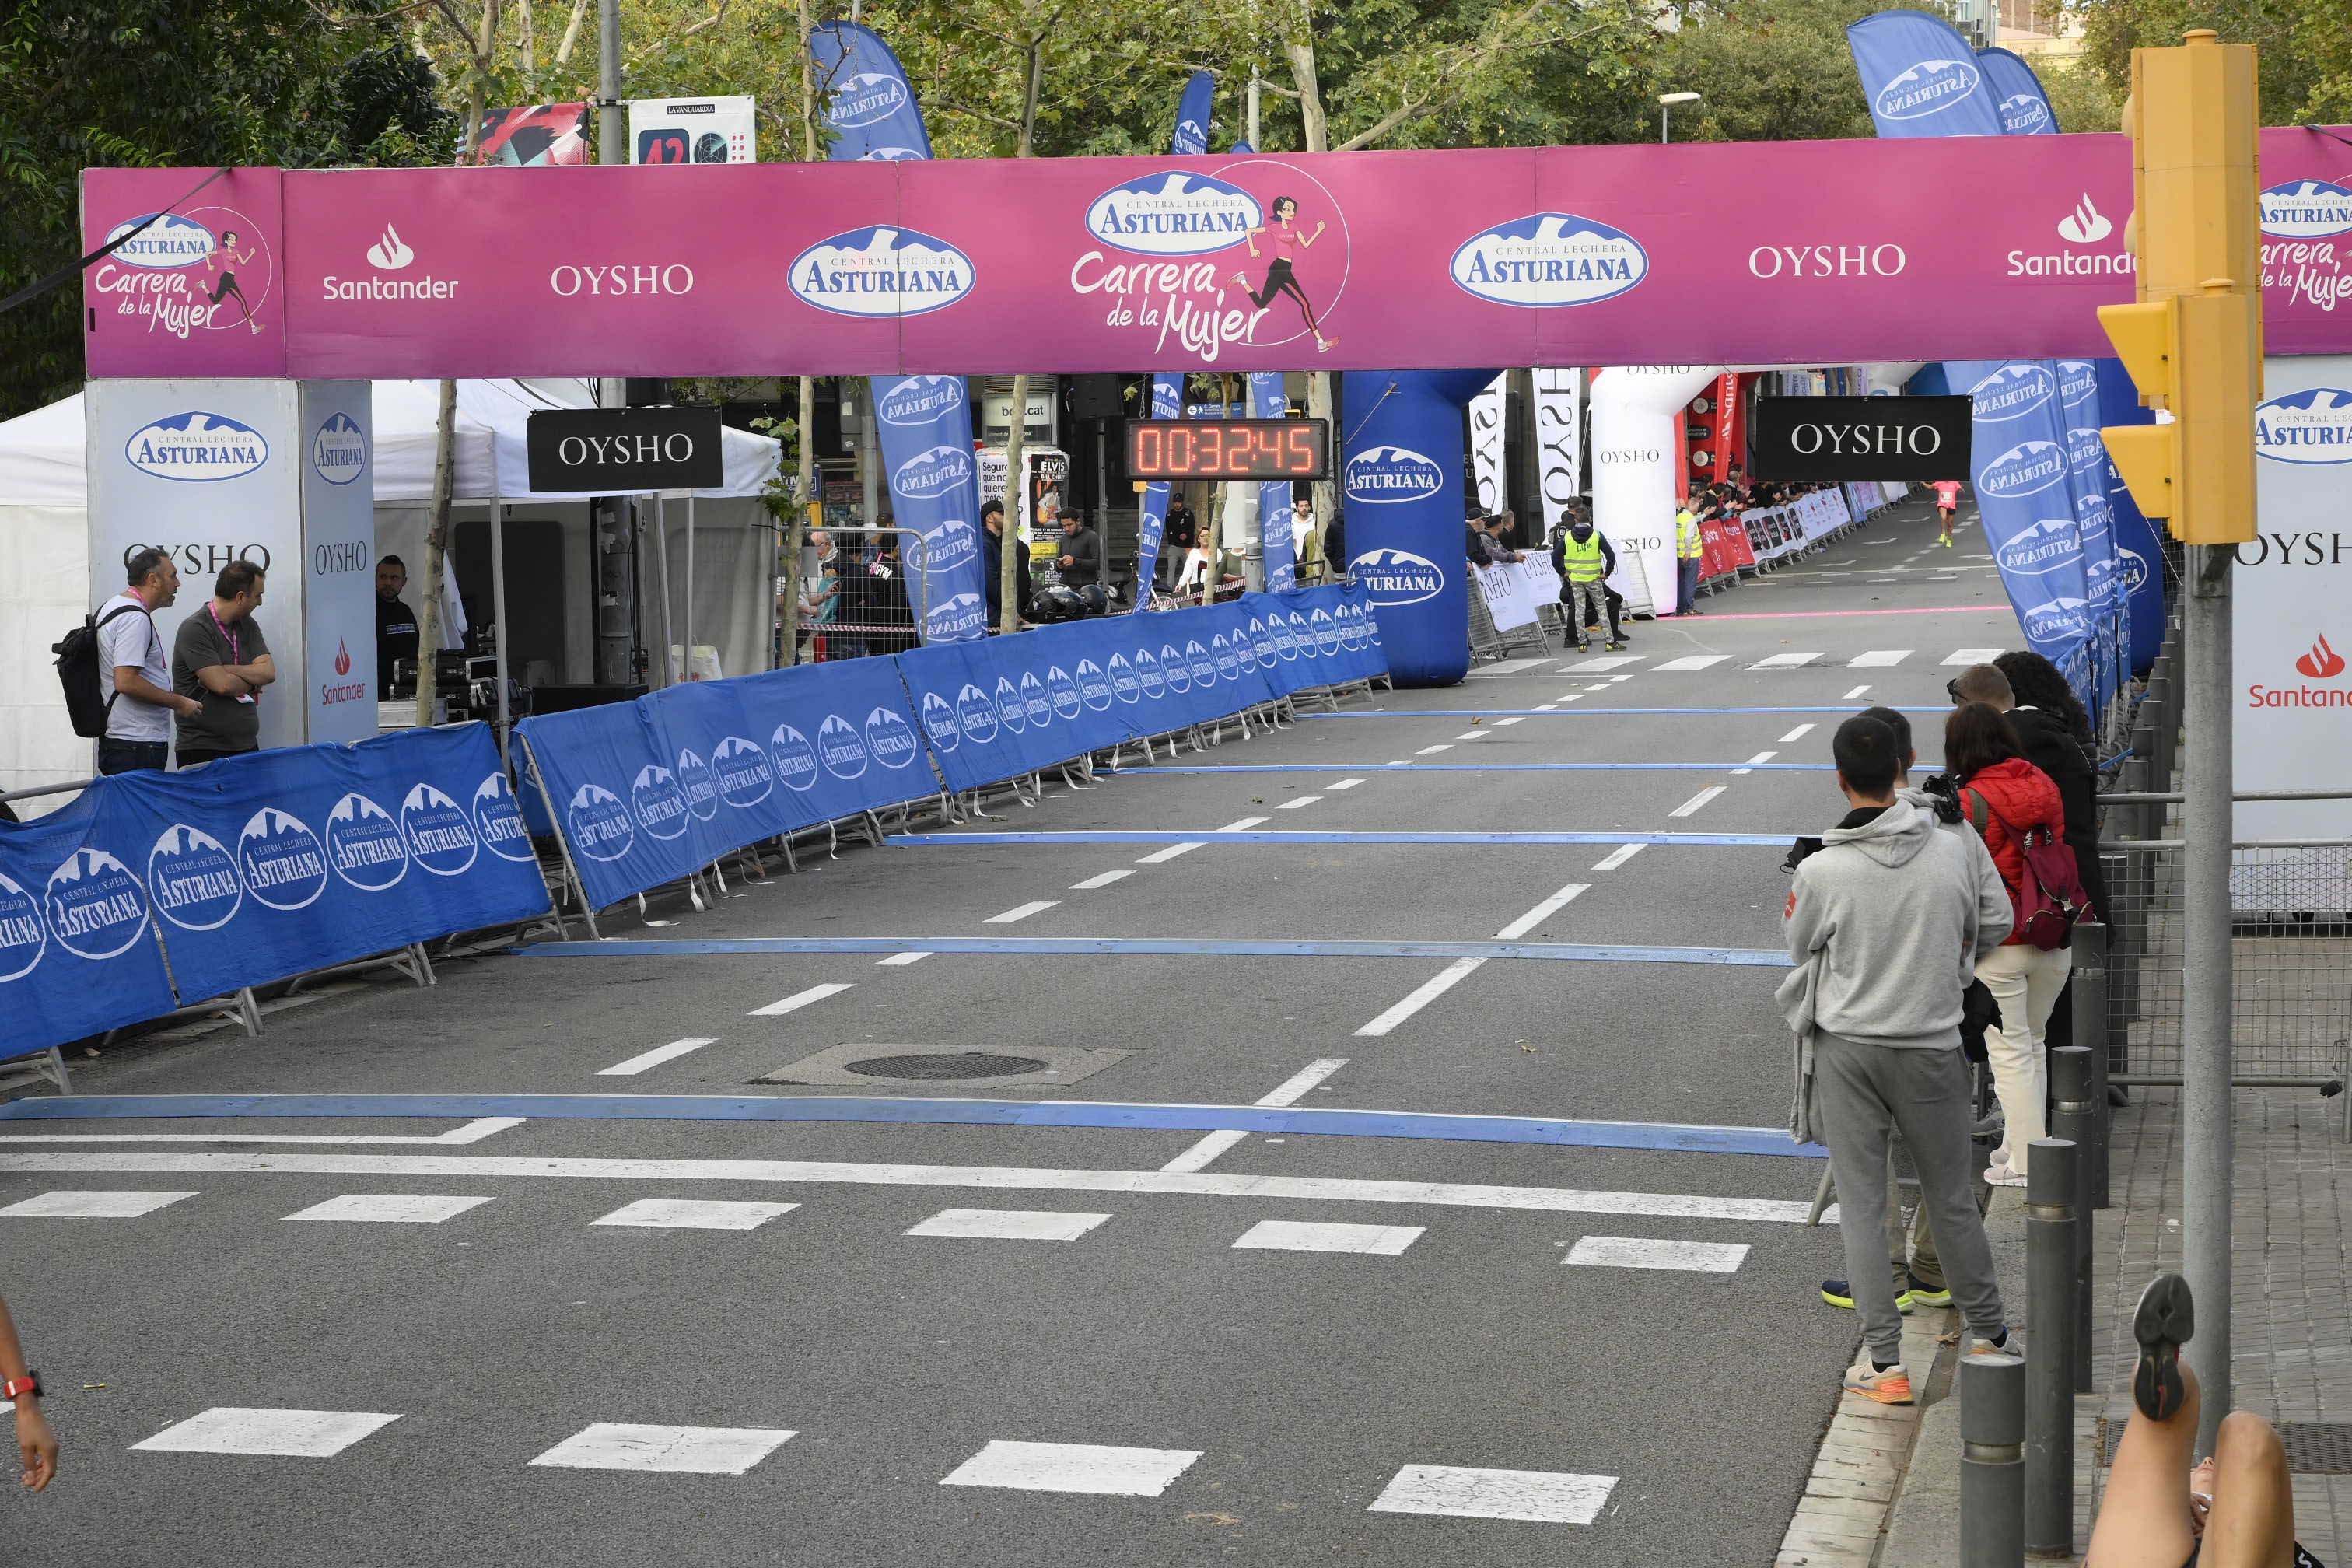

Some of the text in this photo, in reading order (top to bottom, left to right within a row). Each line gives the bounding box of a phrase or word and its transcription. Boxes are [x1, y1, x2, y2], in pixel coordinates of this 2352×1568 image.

[1100, 203, 1248, 234] ASTURIANA
[1127, 199, 1244, 208] CENTRAL LECHERA
[831, 257, 954, 267] CENTRAL LECHERA
[1496, 244, 1626, 256] CENTRAL LECHERA
[1748, 243, 1906, 278] OYSHO
[2007, 250, 2137, 276] Santand
[2260, 243, 2335, 265] arrera
[95, 264, 187, 294] Carrera
[551, 264, 694, 296] OYSHO
[803, 261, 961, 293] ASTURIANA
[1071, 251, 1216, 295] Carrera
[1465, 249, 1633, 284] ASTURIANA
[323, 275, 459, 299] Santander
[2279, 265, 2293, 287] la
[2289, 261, 2352, 312] Muje
[117, 291, 222, 339] de la Mujer
[1107, 289, 1271, 362] de la Mujer
[136, 438, 258, 464] ASTURIANA
[317, 440, 362, 467] ASTURIANA
[558, 433, 694, 466] OYSHO
[1138, 428, 1313, 472] 00:32:45
[1791, 423, 1941, 456] OYSHO
[1041, 461, 1065, 471] ELVIS
[1601, 449, 1660, 464] OYSHO
[1348, 469, 1436, 491] ASTURIANA
[315, 541, 367, 576] OYSHO
[1352, 570, 1437, 591] TURIANA
[321, 679, 366, 705] Santander
[254, 837, 312, 856] CENTRAL LECHERA
[334, 833, 405, 870] ASTURIANA
[408, 821, 474, 856] ASTURIANA
[166, 855, 226, 875] CENTRAL LECHERA
[246, 850, 324, 890] ASTURIANA
[157, 869, 239, 910] ASTURIANA
